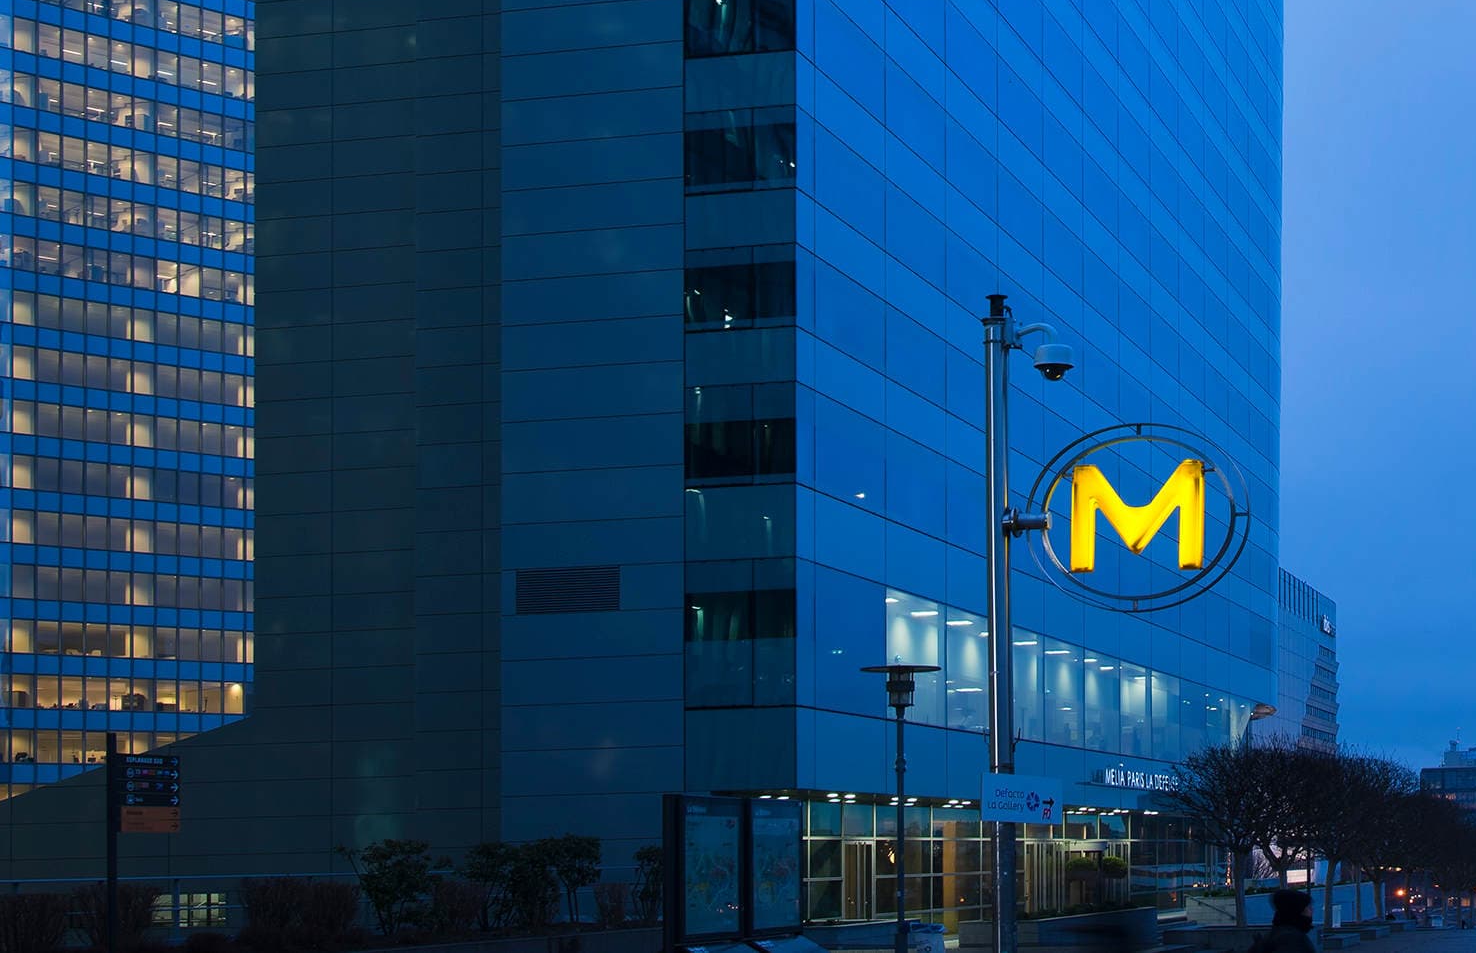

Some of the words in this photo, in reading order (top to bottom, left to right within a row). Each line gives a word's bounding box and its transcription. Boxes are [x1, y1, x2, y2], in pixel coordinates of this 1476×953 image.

[1070, 458, 1205, 573] M
[1127, 770, 1145, 788] PARIS
[1146, 773, 1154, 789] LA
